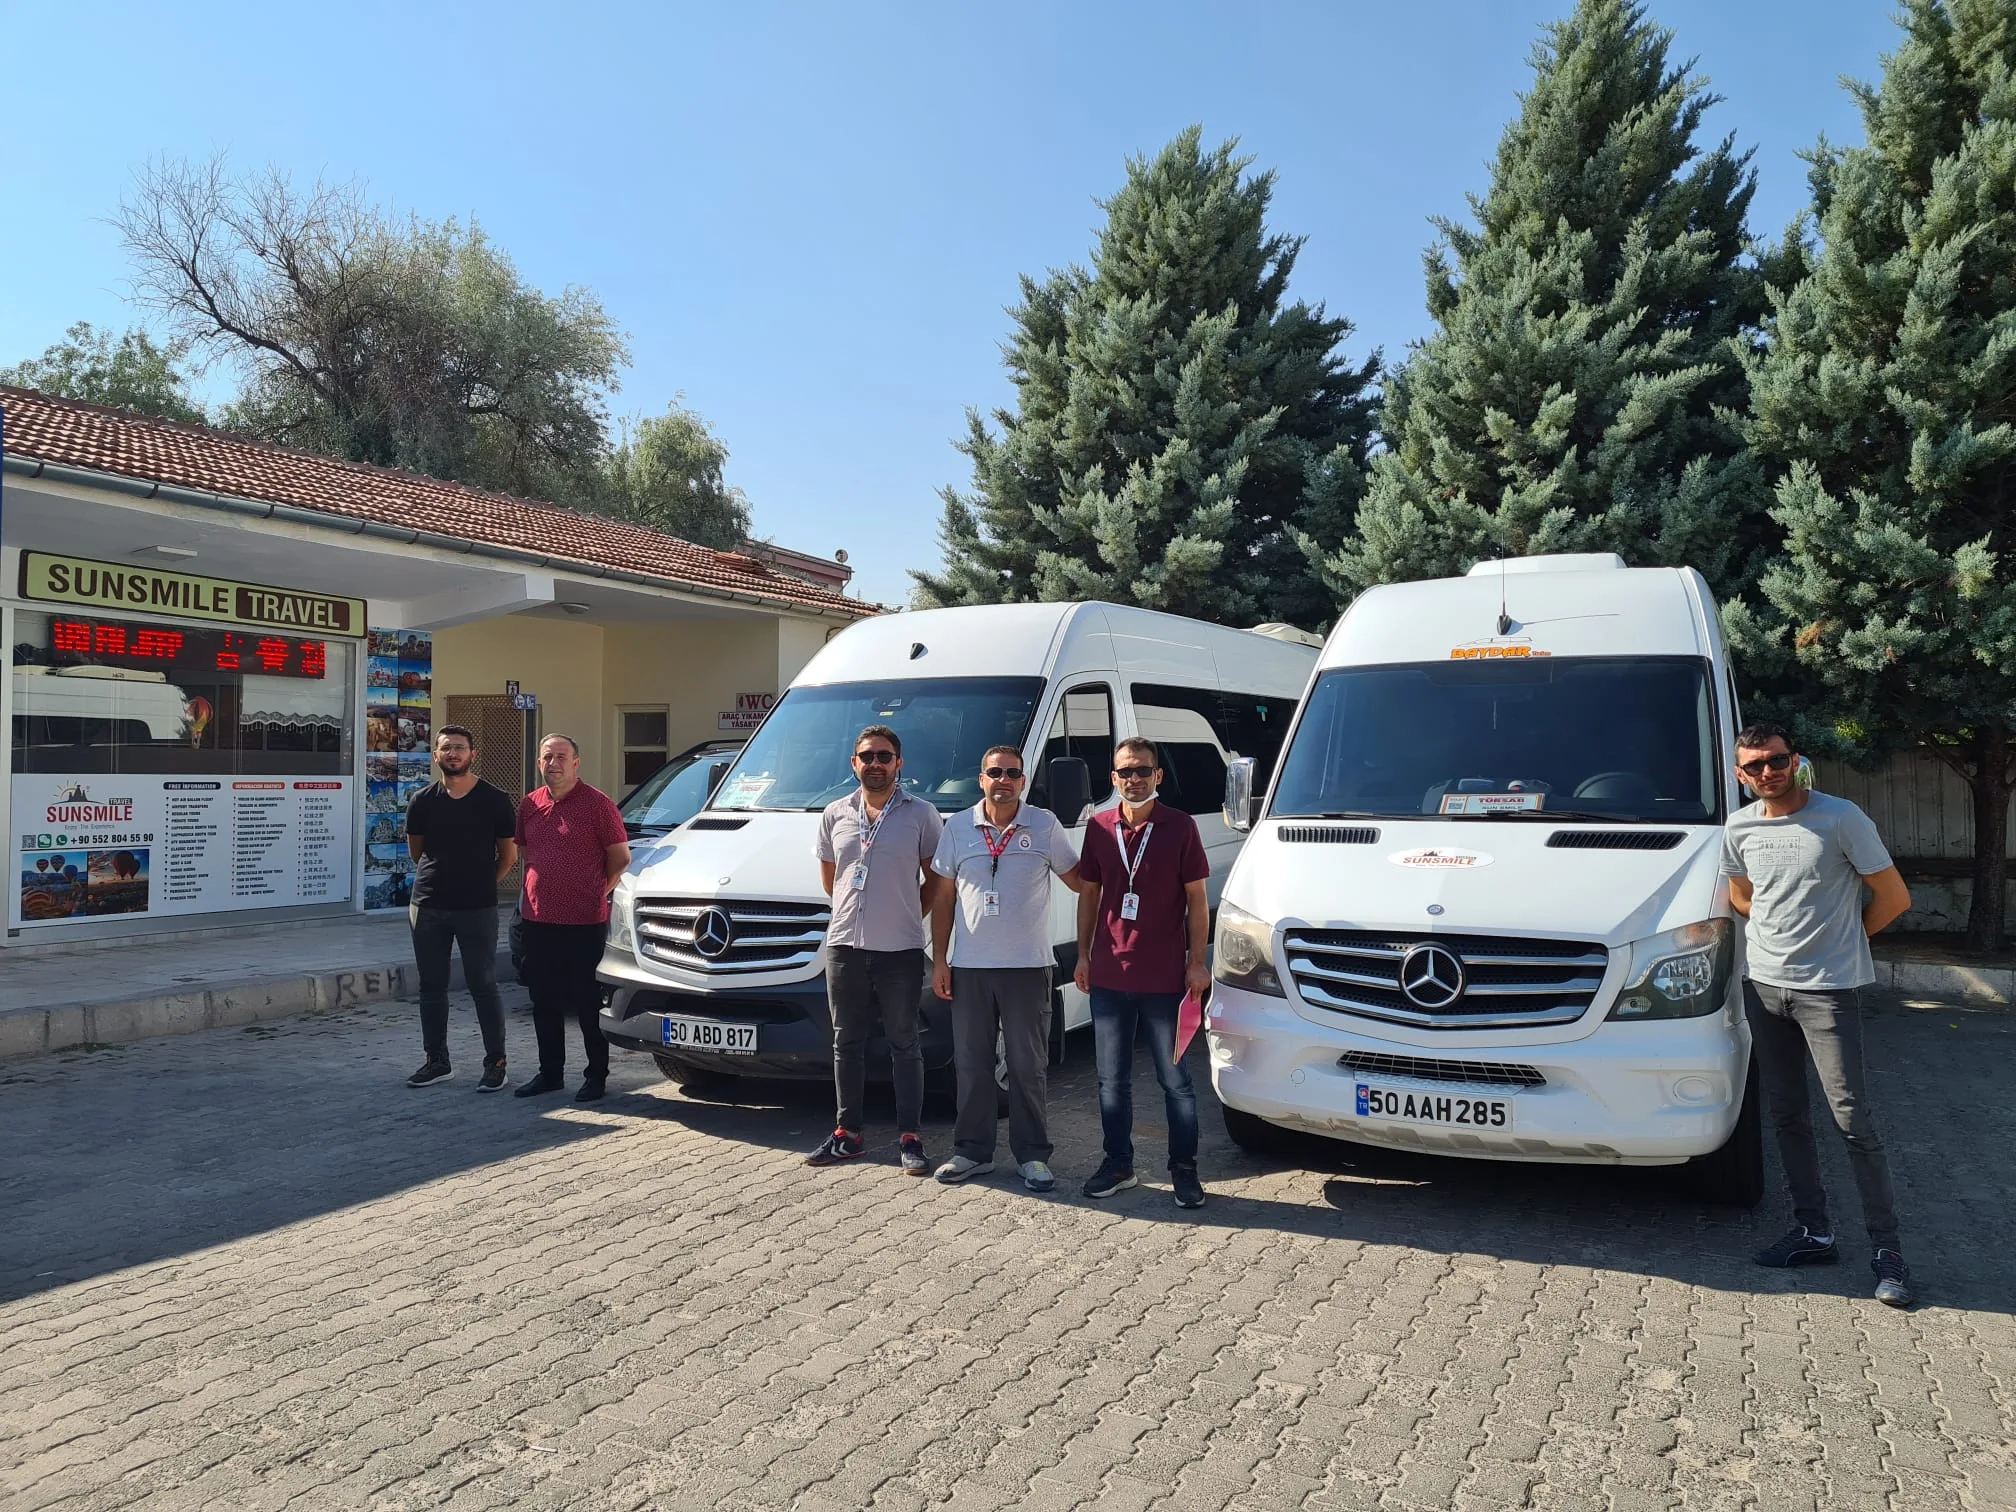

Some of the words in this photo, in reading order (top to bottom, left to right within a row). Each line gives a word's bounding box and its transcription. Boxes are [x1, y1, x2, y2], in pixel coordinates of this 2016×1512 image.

[48, 563, 229, 614] SUNSMILE
[248, 591, 340, 628] TRAVEL
[1450, 646, 1531, 659] BAYDAR
[745, 694, 773, 710] WC
[731, 720, 762, 728] YASAKTI
[47, 805, 133, 823] SUNSMILE
[71, 835, 90, 845] +90
[92, 834, 109, 844] 552
[111, 834, 128, 843] 804
[130, 833, 141, 842] 55
[143, 833, 154, 842] 90
[1403, 857, 1475, 865] SUNSMILE
[671, 1021, 687, 1041] 50
[693, 1024, 722, 1045] ABD
[726, 1027, 754, 1048] 817
[1359, 1102, 1367, 1111] TR
